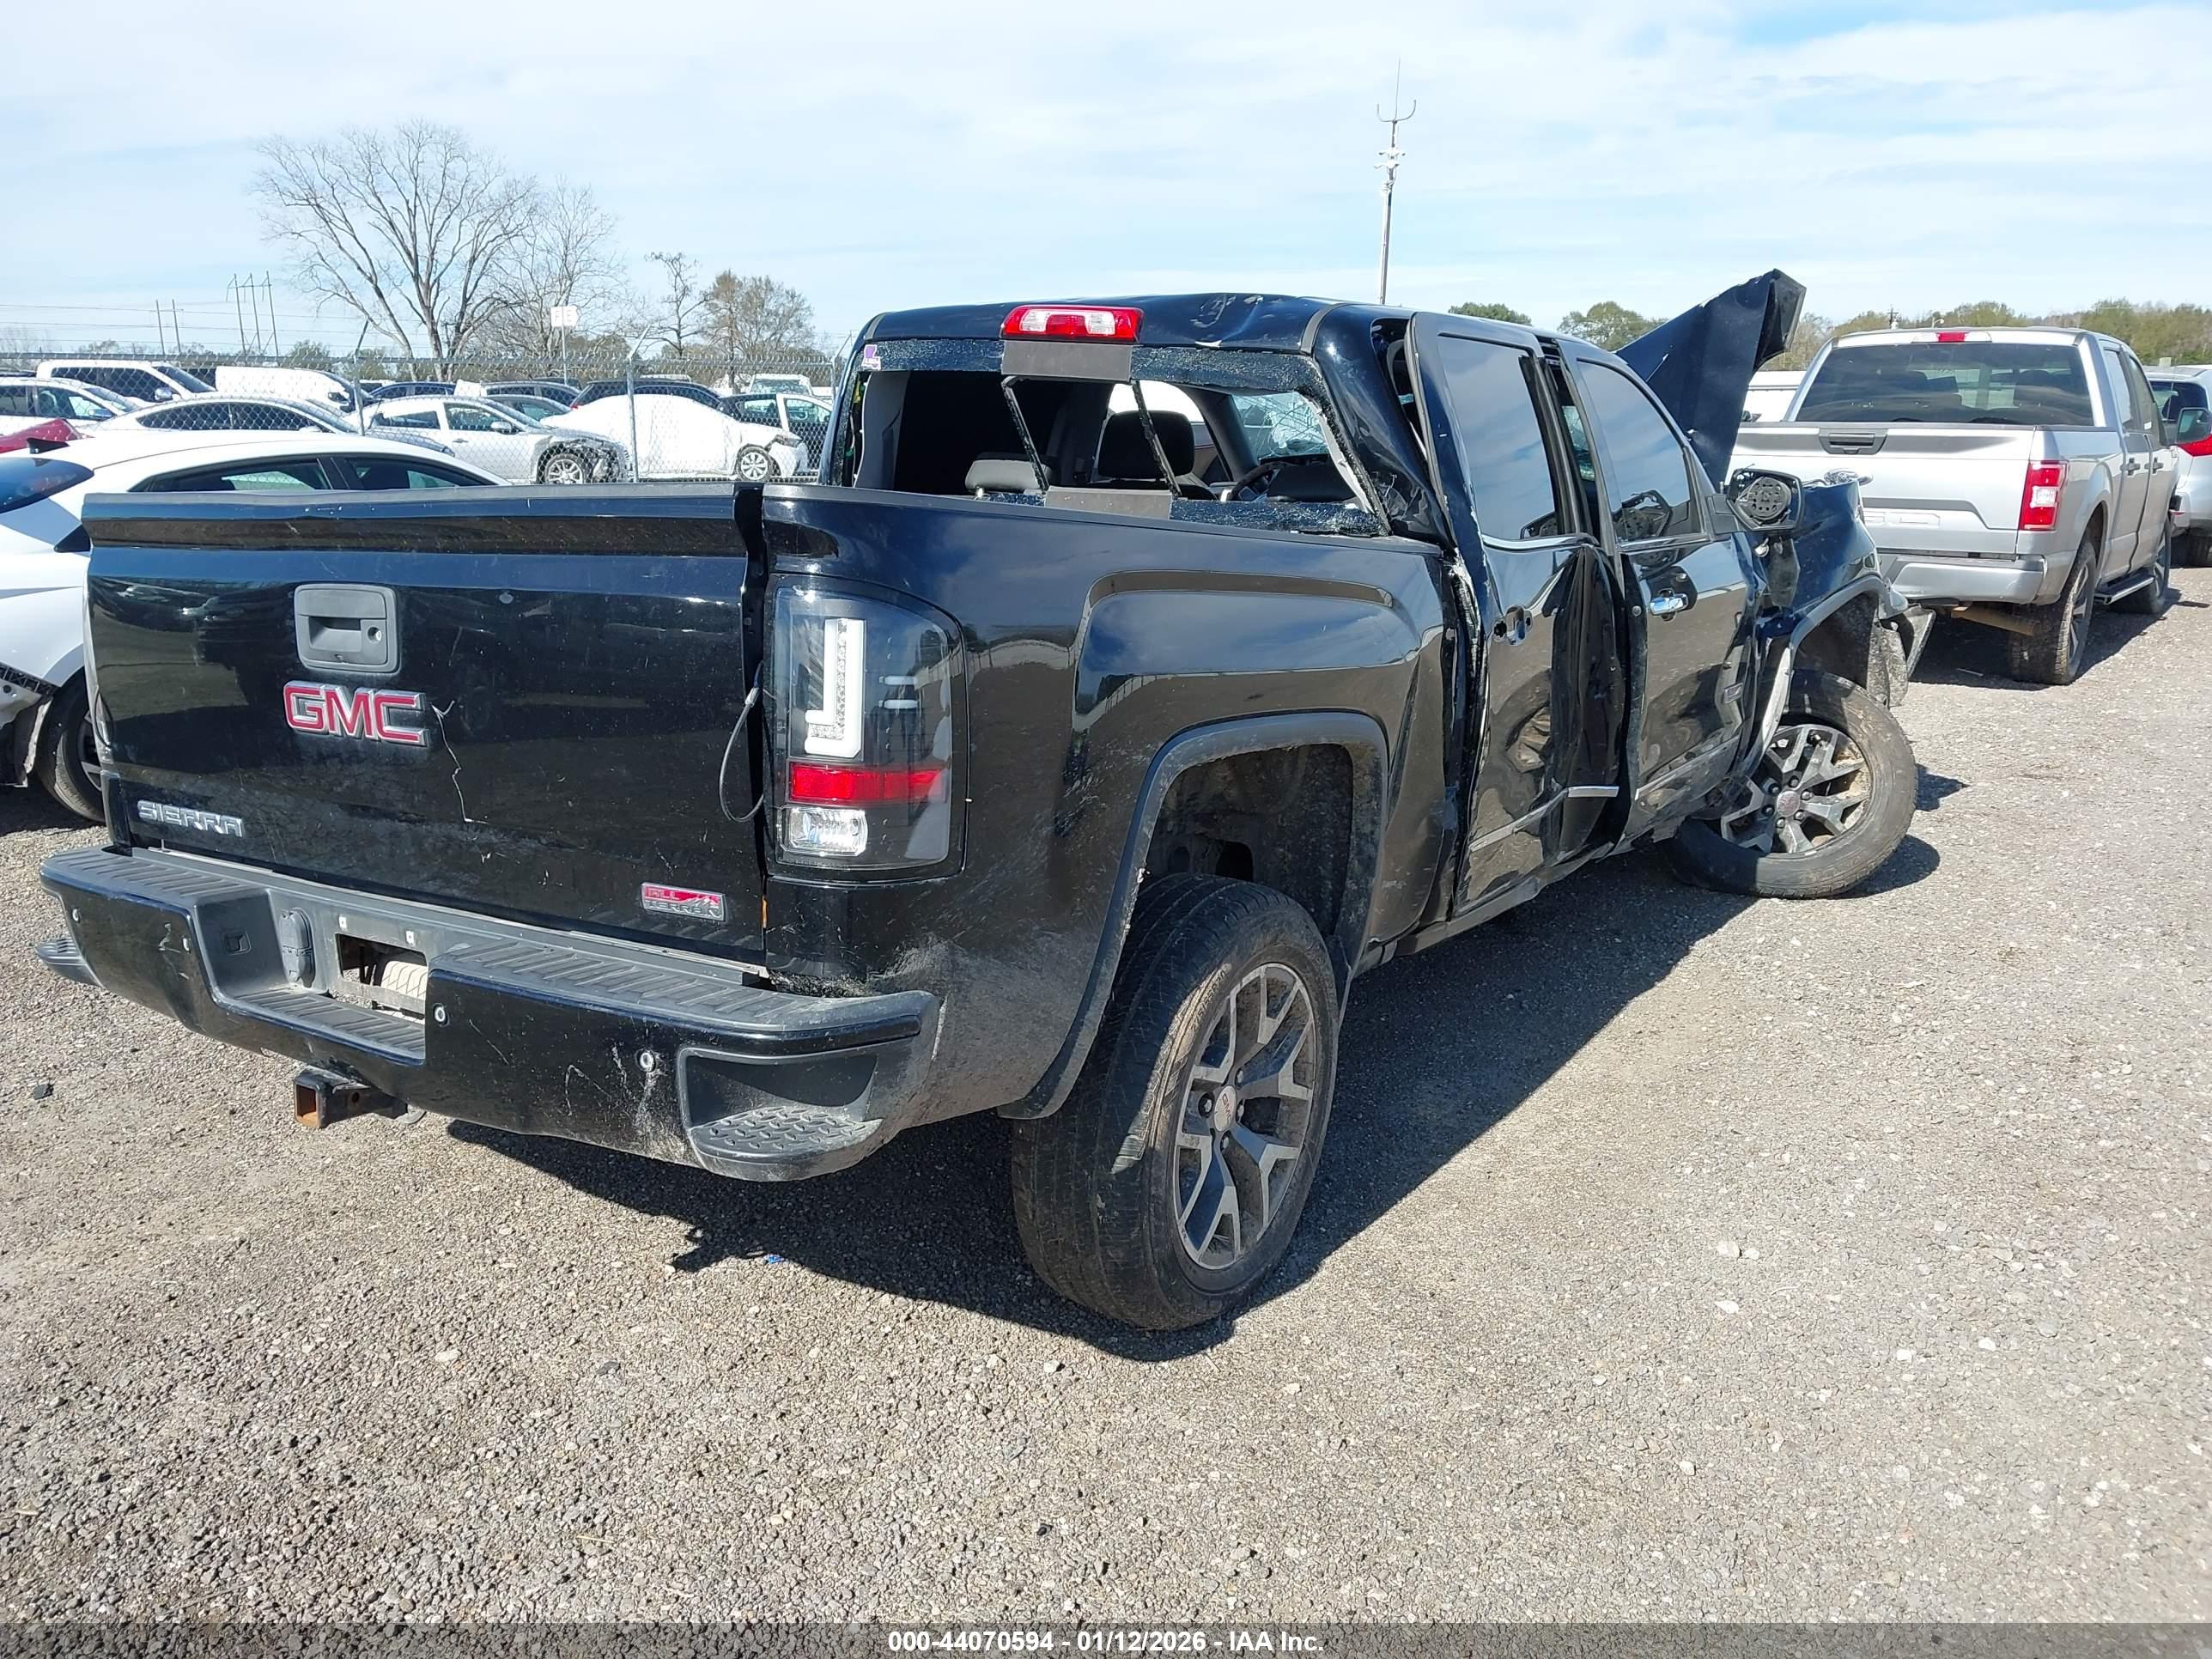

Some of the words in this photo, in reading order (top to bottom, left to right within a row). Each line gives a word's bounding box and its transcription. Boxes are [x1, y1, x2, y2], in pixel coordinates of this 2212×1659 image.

[283, 680, 427, 747] GMC
[137, 799, 243, 837] SIERRA
[645, 886, 681, 901] ALL
